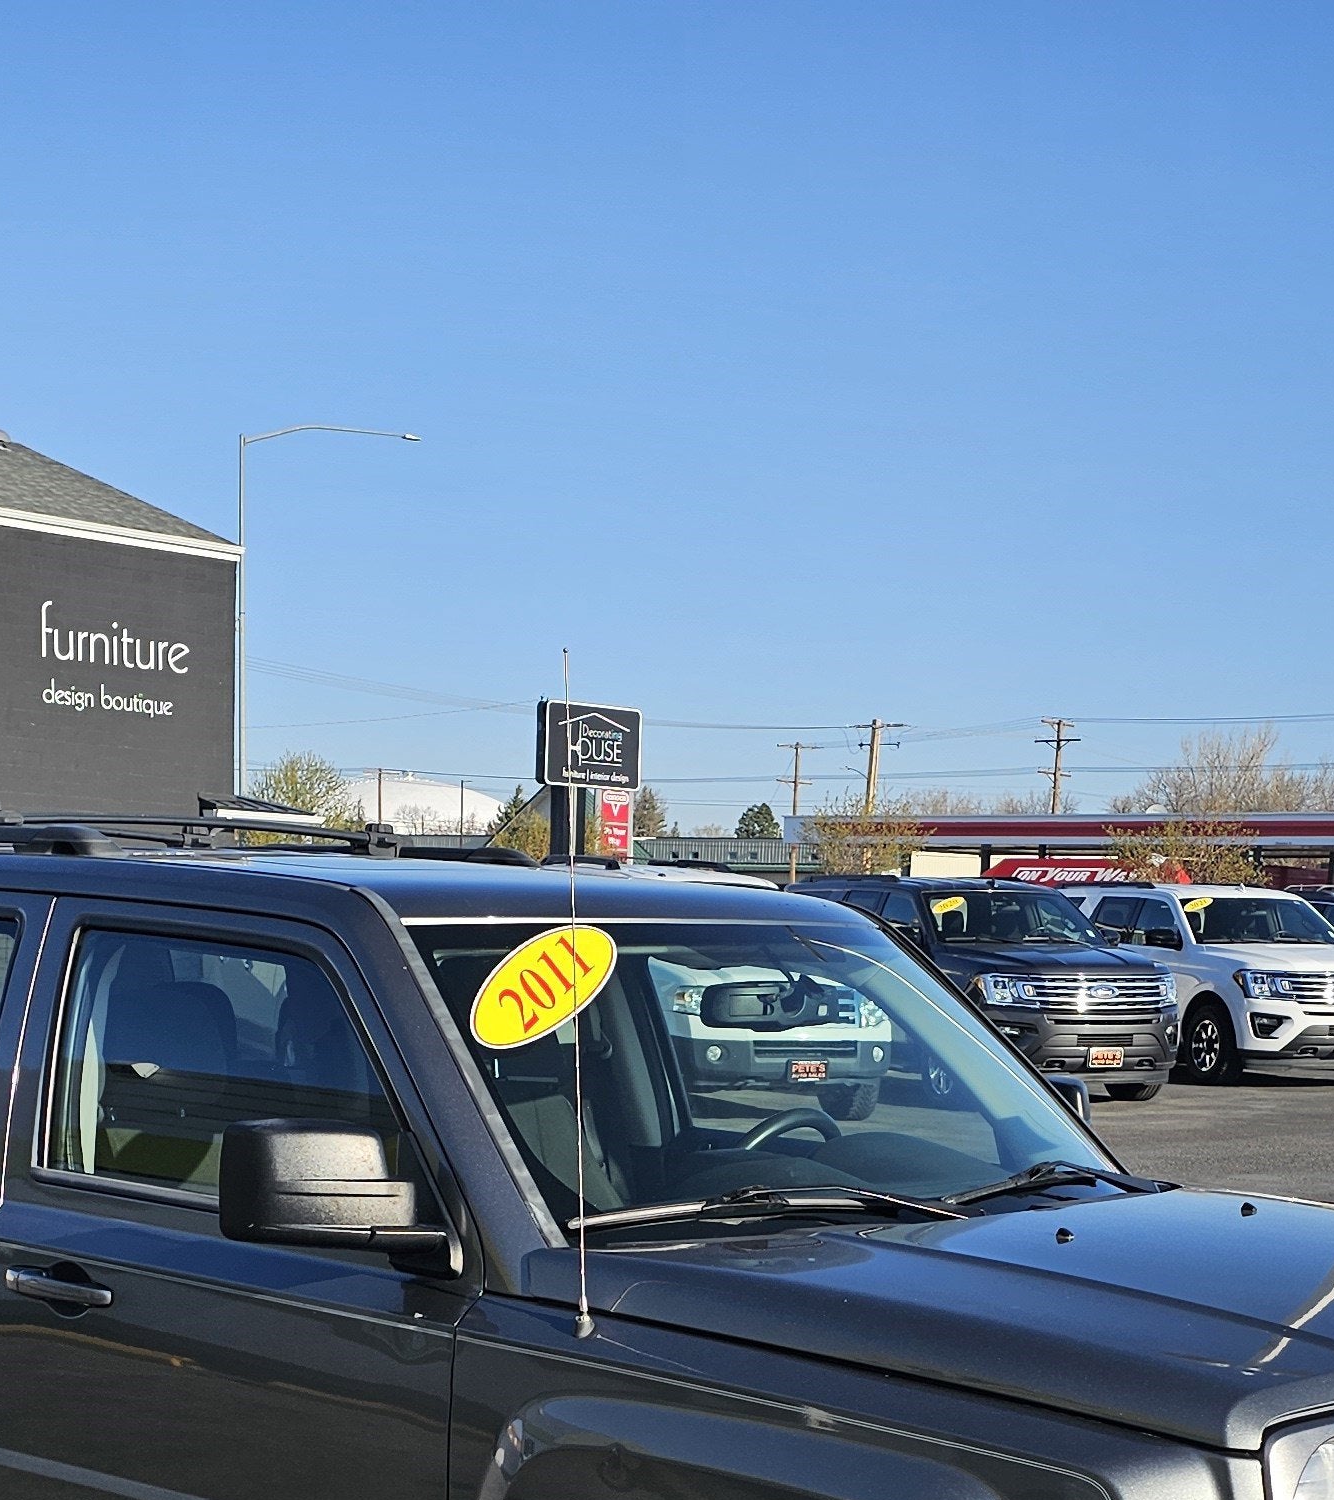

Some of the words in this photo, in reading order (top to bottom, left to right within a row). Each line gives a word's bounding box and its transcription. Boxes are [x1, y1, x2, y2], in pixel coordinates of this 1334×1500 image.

[41, 600, 190, 674] furniture
[42, 678, 95, 711] design
[100, 684, 174, 718] boutique
[582, 723, 623, 741] Decorating
[611, 771, 630, 785] design
[1018, 869, 1044, 882] ON
[1039, 867, 1087, 883] YOUR
[498, 936, 595, 1034] 2011
[792, 1063, 826, 1073] PETE'S
